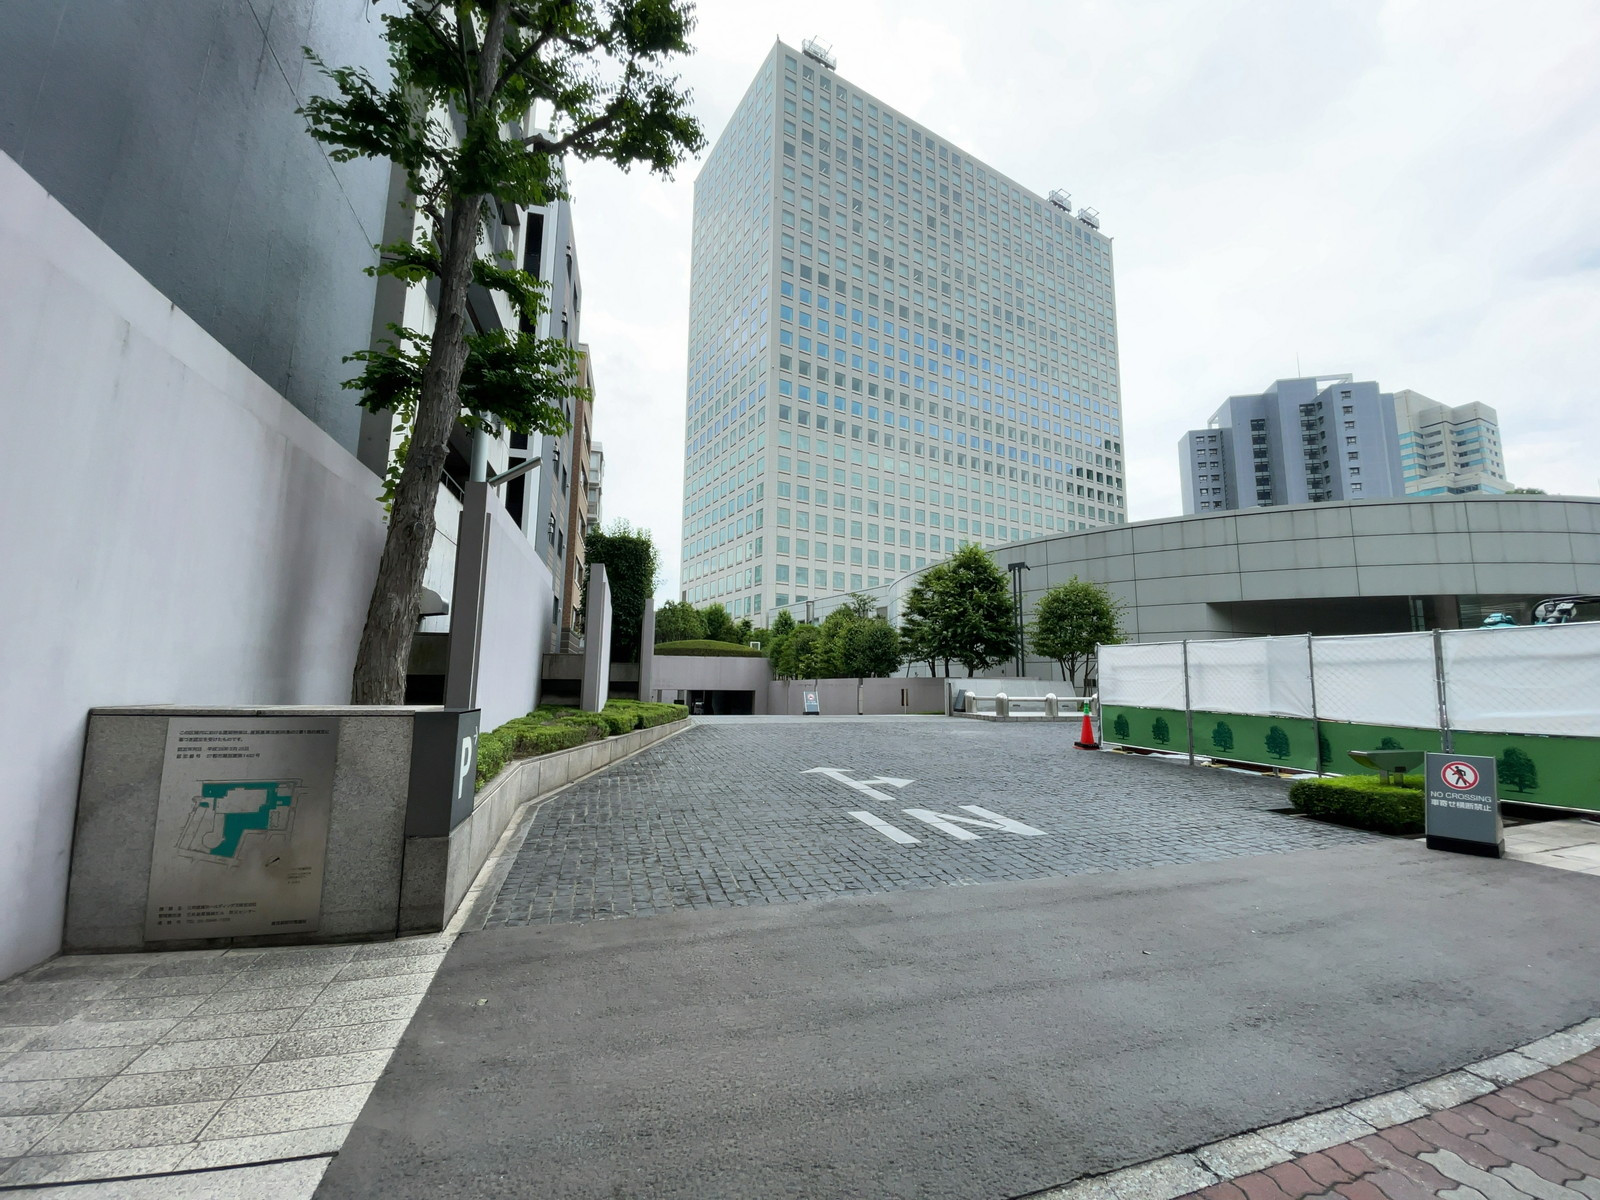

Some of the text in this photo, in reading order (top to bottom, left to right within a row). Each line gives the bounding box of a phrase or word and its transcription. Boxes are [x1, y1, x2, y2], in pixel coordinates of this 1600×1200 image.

[458, 736, 472, 800] P
[1430, 799, 1492, 812] 車寄せ横断禁止
[1445, 792, 1492, 803] CROSSING
[848, 805, 1048, 844] IN
